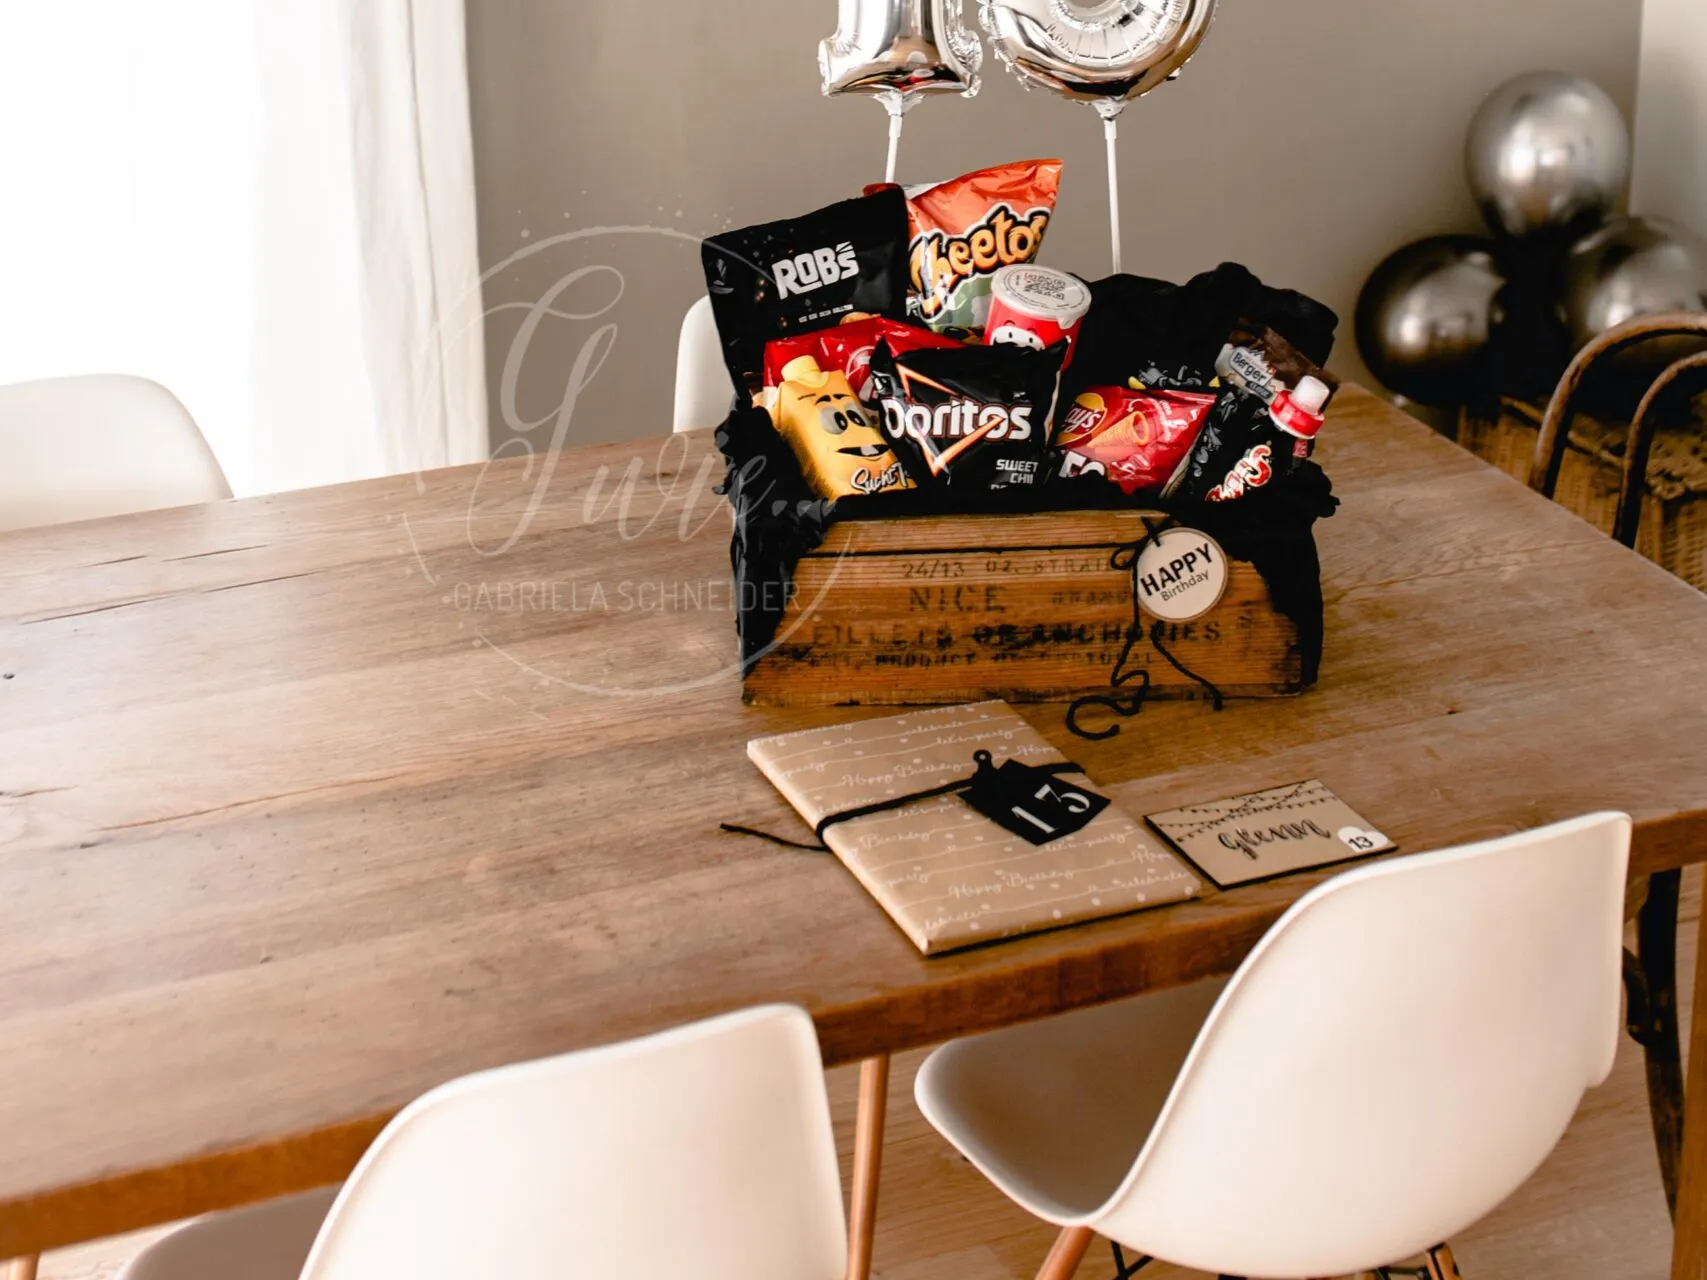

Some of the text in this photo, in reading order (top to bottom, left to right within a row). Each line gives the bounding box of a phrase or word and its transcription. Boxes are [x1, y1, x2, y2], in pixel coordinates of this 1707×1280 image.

[881, 396, 1032, 441] Doritos
[996, 459, 1039, 473] SWEET
[902, 560, 965, 579] 24/13
[1140, 543, 1212, 597] HAPPY
[908, 585, 1007, 612] NICE
[1160, 569, 1209, 602] Birthday
[1010, 784, 1091, 833] 13
[1348, 835, 1374, 851] 13
